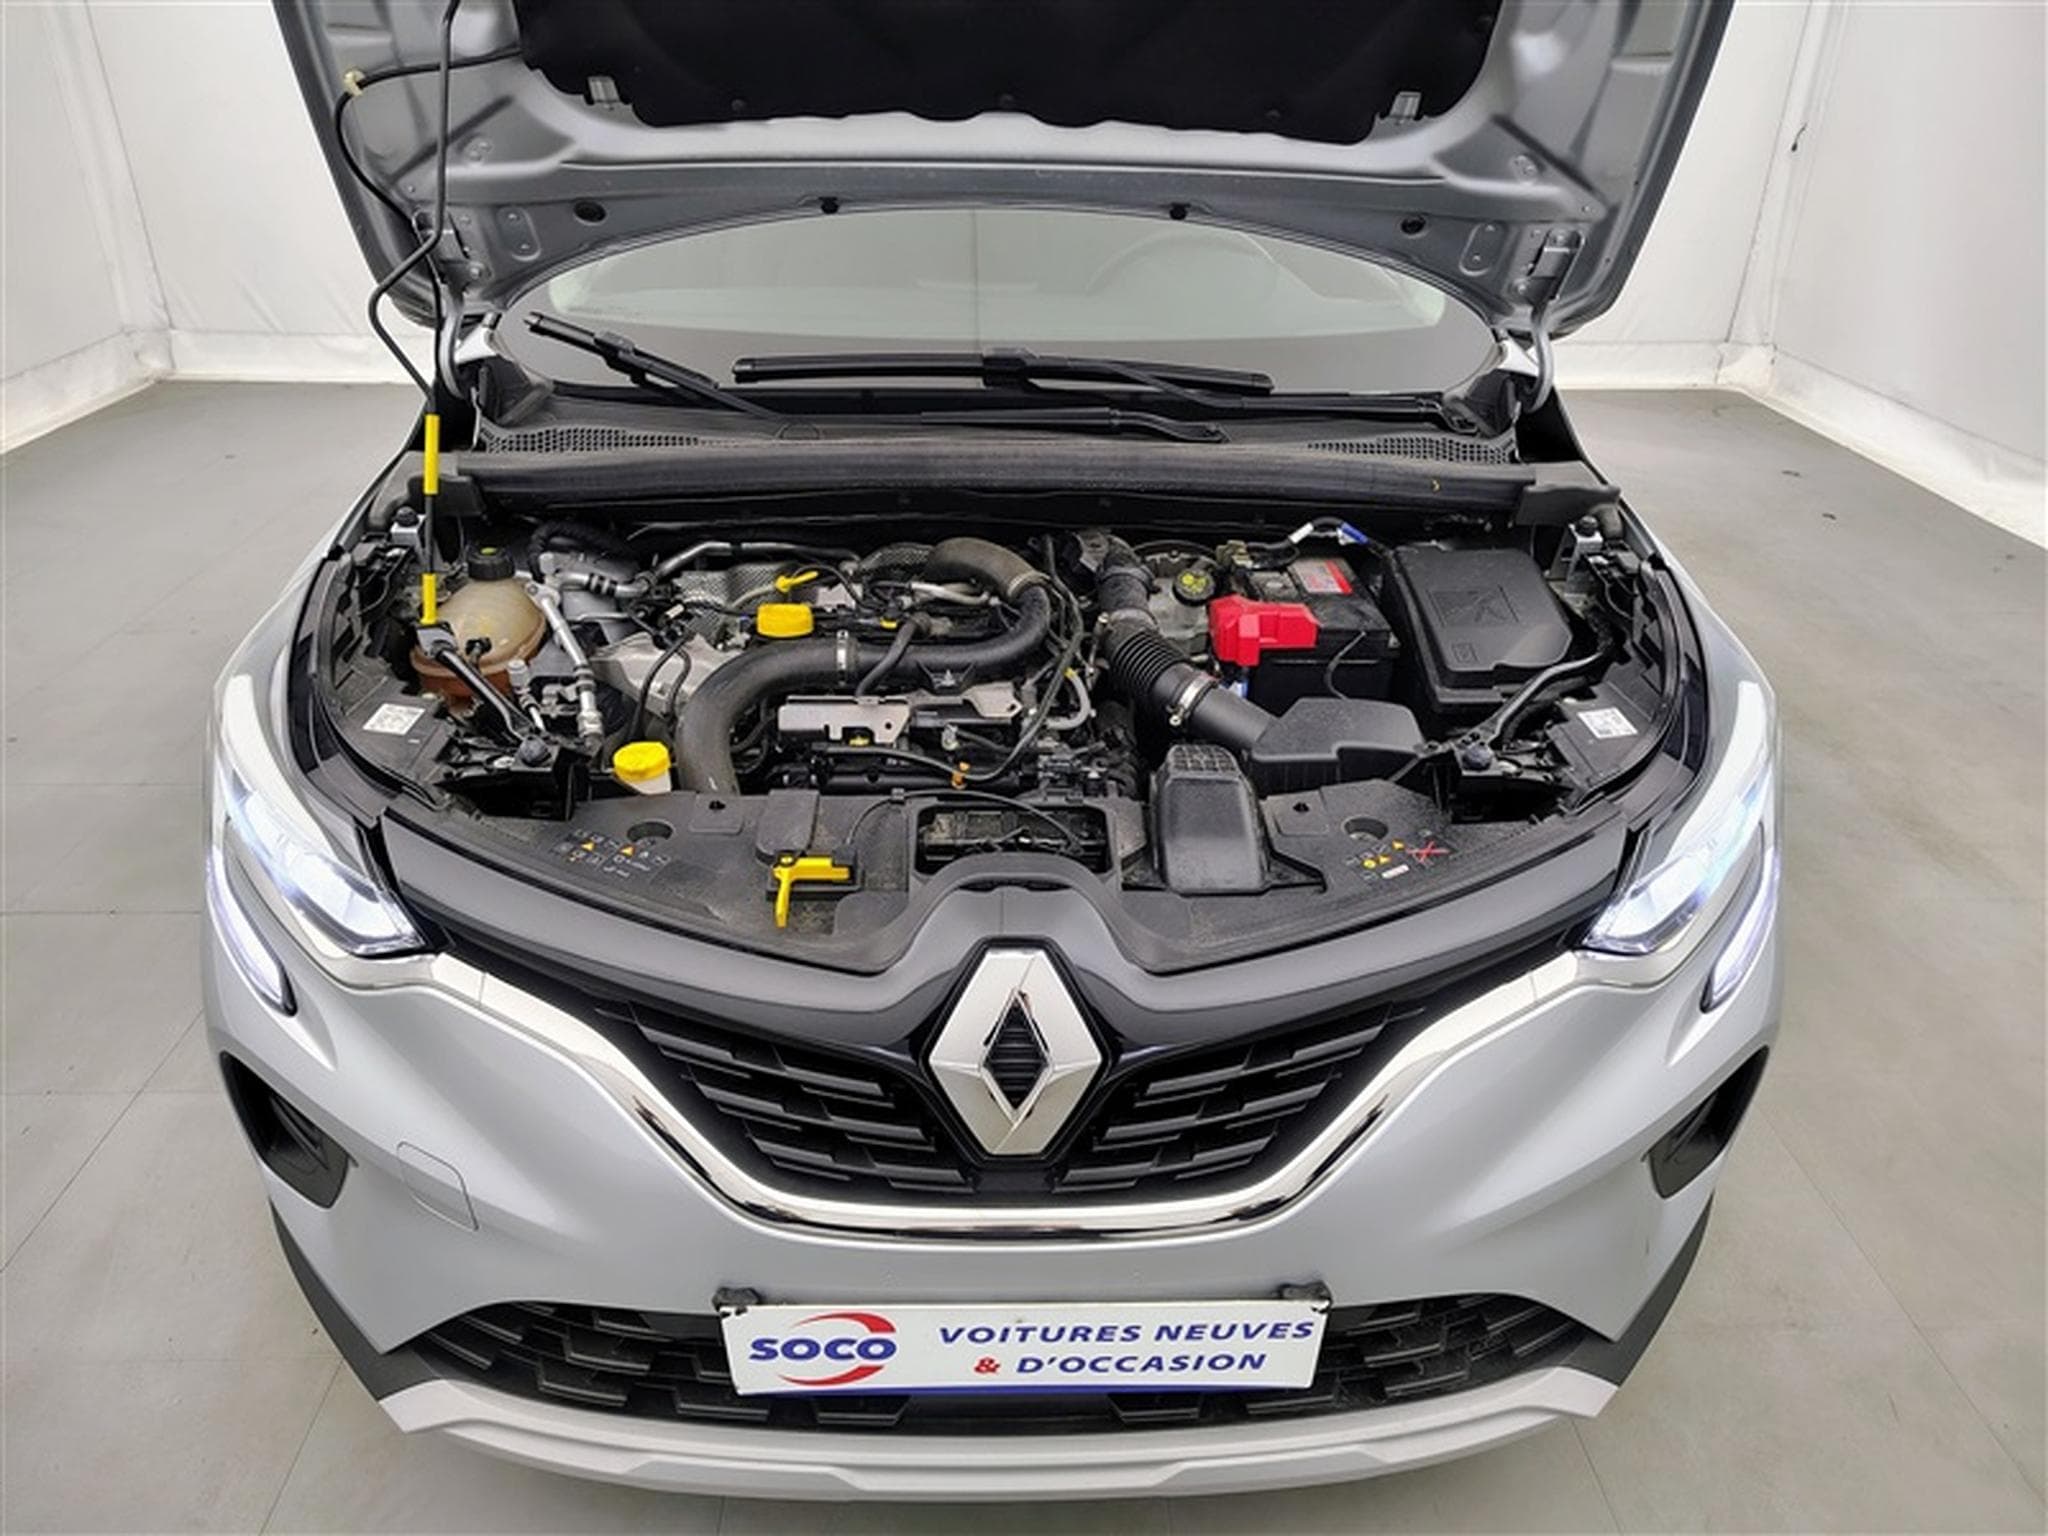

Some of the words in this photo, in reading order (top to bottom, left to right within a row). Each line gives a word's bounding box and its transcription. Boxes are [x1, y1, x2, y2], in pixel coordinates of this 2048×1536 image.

[939, 1325, 1142, 1344] VOITURES
[1154, 1321, 1315, 1341] NEUVES
[749, 1338, 896, 1361] SOCO
[974, 1357, 1000, 1375] &
[1016, 1353, 1267, 1374] D'OCCASION
